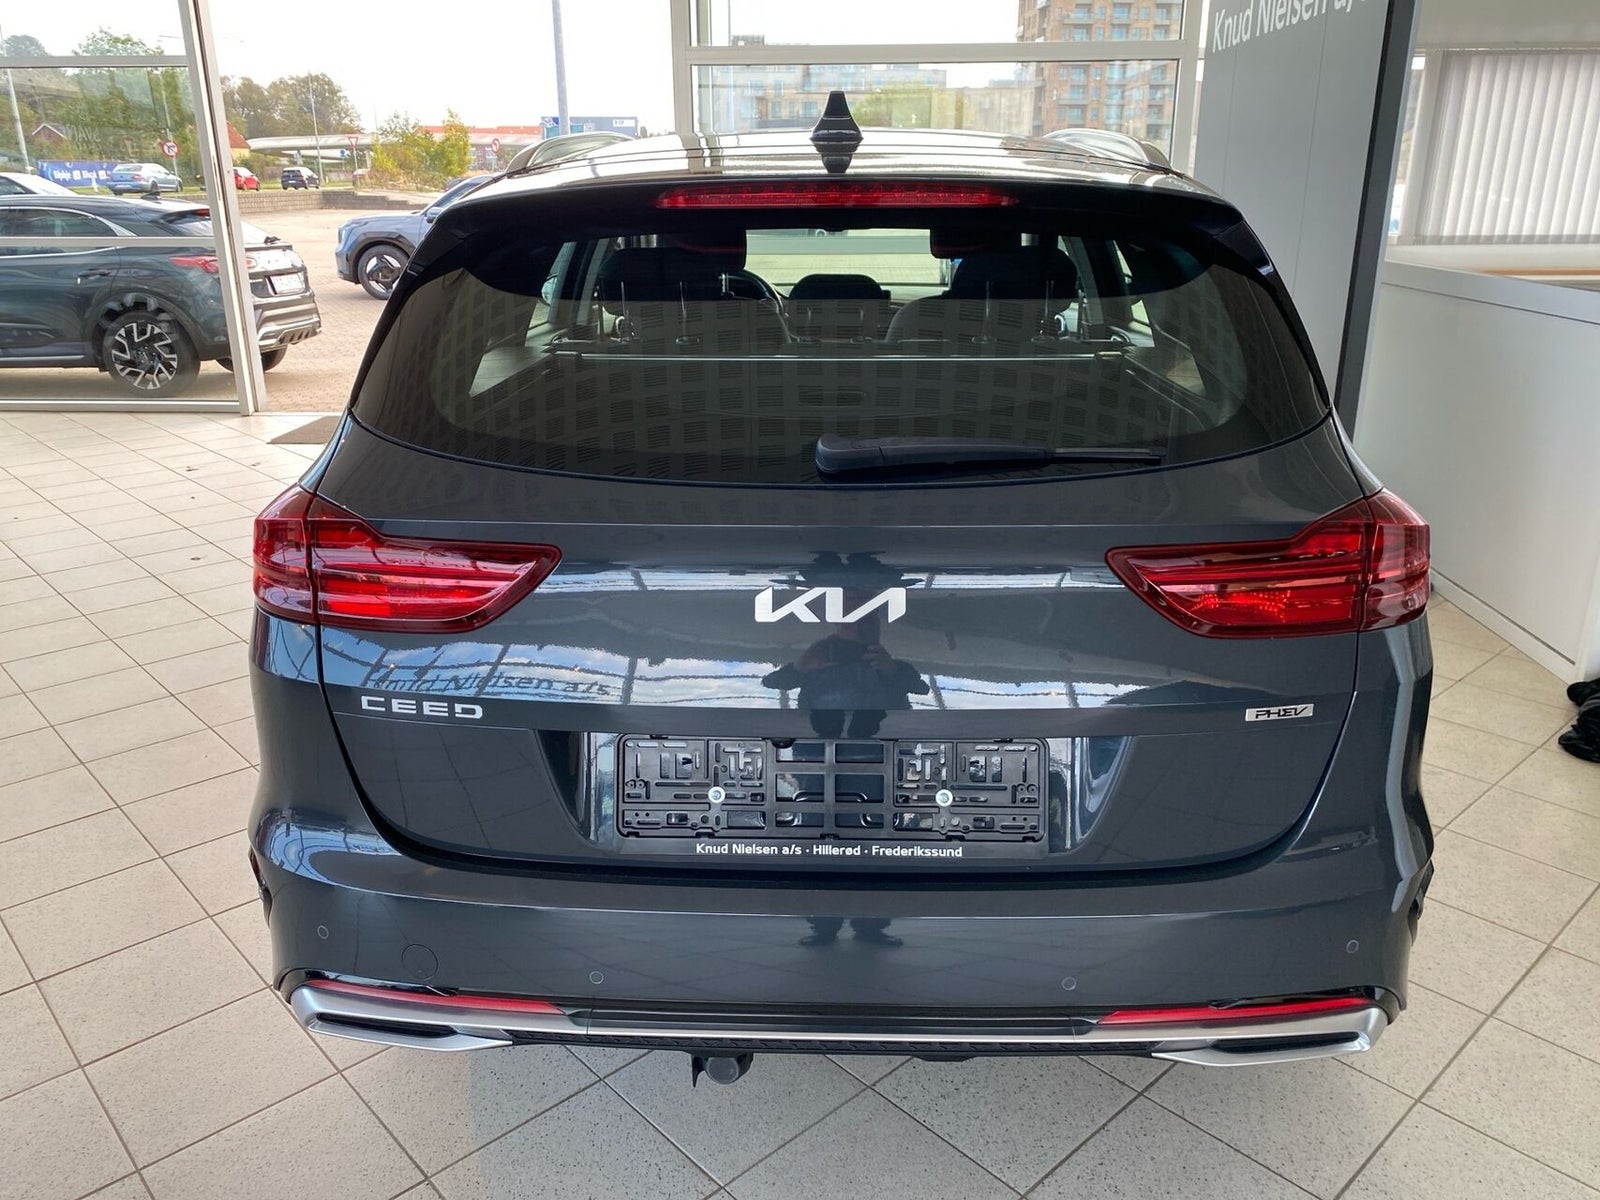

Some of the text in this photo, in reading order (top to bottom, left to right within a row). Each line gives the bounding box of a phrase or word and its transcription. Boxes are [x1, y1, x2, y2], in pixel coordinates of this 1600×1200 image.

[1212, 0, 1253, 53] Knud
[755, 586, 907, 623] KIA
[360, 695, 484, 719] CEED
[1254, 705, 1309, 719] PHEV
[695, 843, 963, 857] Knud Nielsen a/s Hillerød Frederikssund
